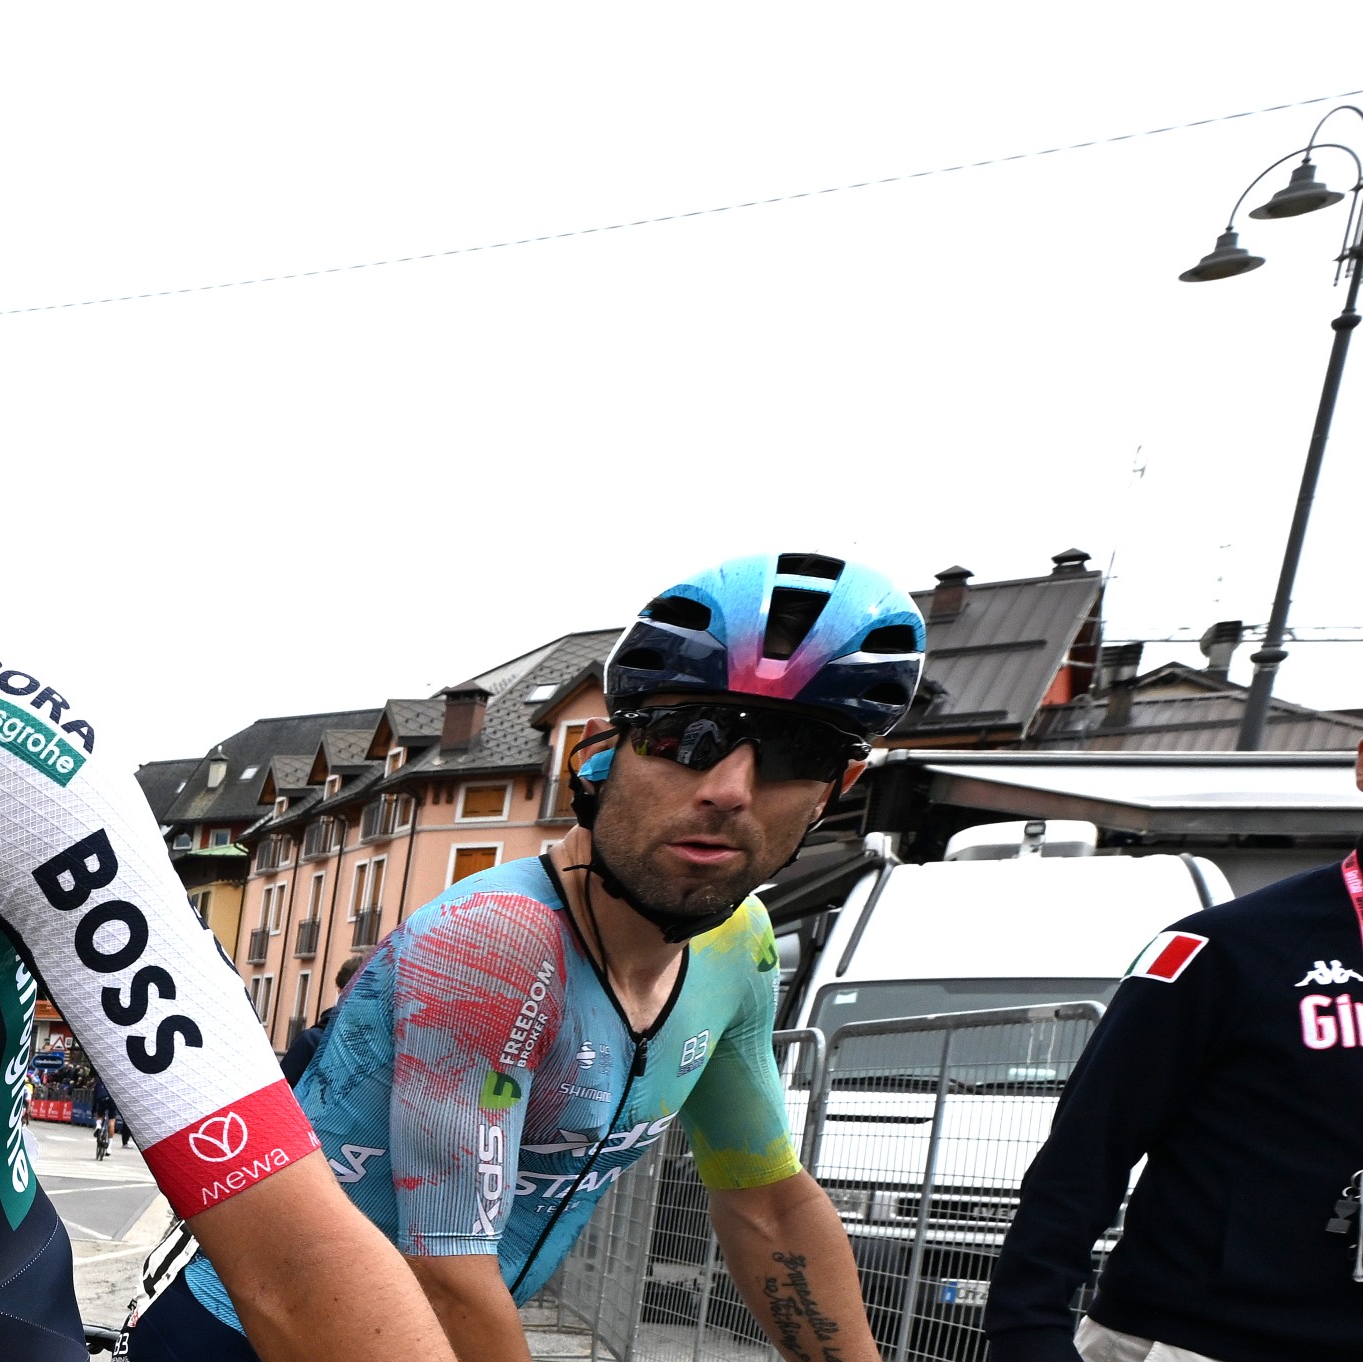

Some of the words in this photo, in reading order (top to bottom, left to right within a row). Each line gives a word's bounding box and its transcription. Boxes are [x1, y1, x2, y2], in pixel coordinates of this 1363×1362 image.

[32, 827, 204, 1076] BOSS
[498, 960, 556, 1066] FREEDOM
[517, 1013, 550, 1069] BROKER
[679, 1029, 711, 1067] B3
